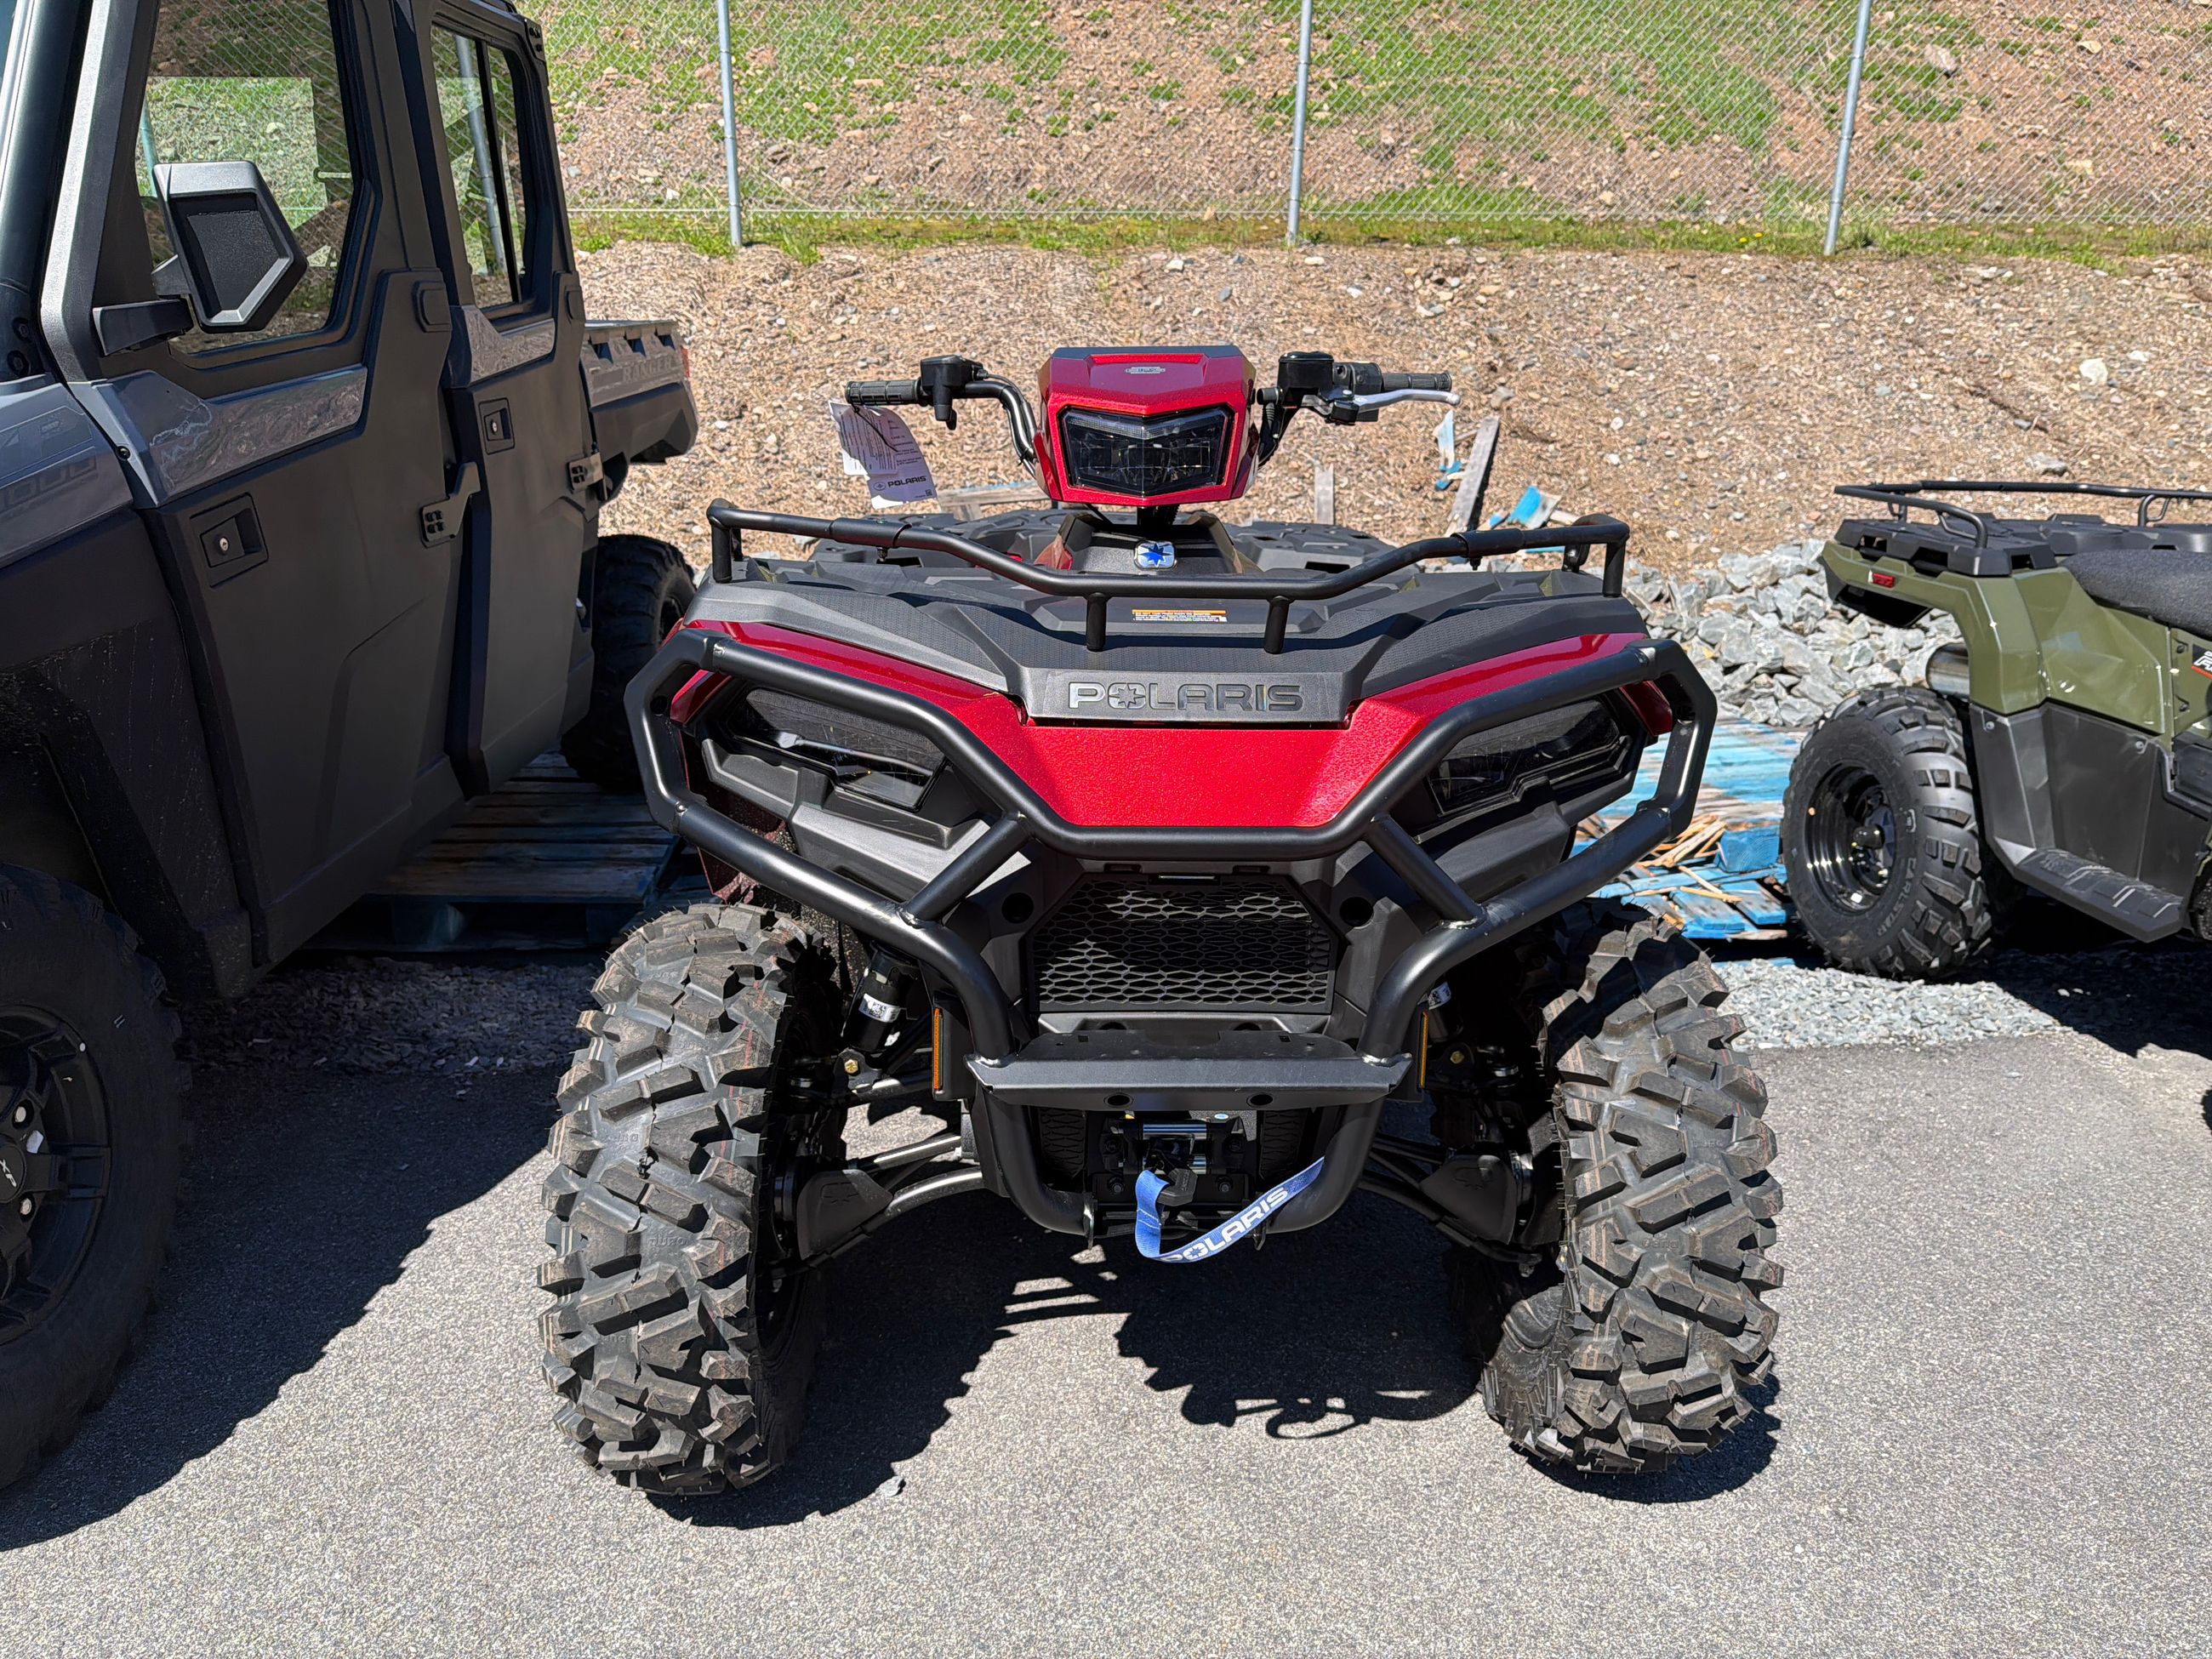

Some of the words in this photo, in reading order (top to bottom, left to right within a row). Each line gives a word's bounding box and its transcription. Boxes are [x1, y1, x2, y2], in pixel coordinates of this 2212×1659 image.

[887, 476, 926, 487] POLARIS
[1069, 681, 1304, 711] POLARIS
[1877, 857, 1917, 936] CARLSTAR
[0, 1159, 17, 1188] XP
[1160, 1187, 1288, 1263] POLARIS
